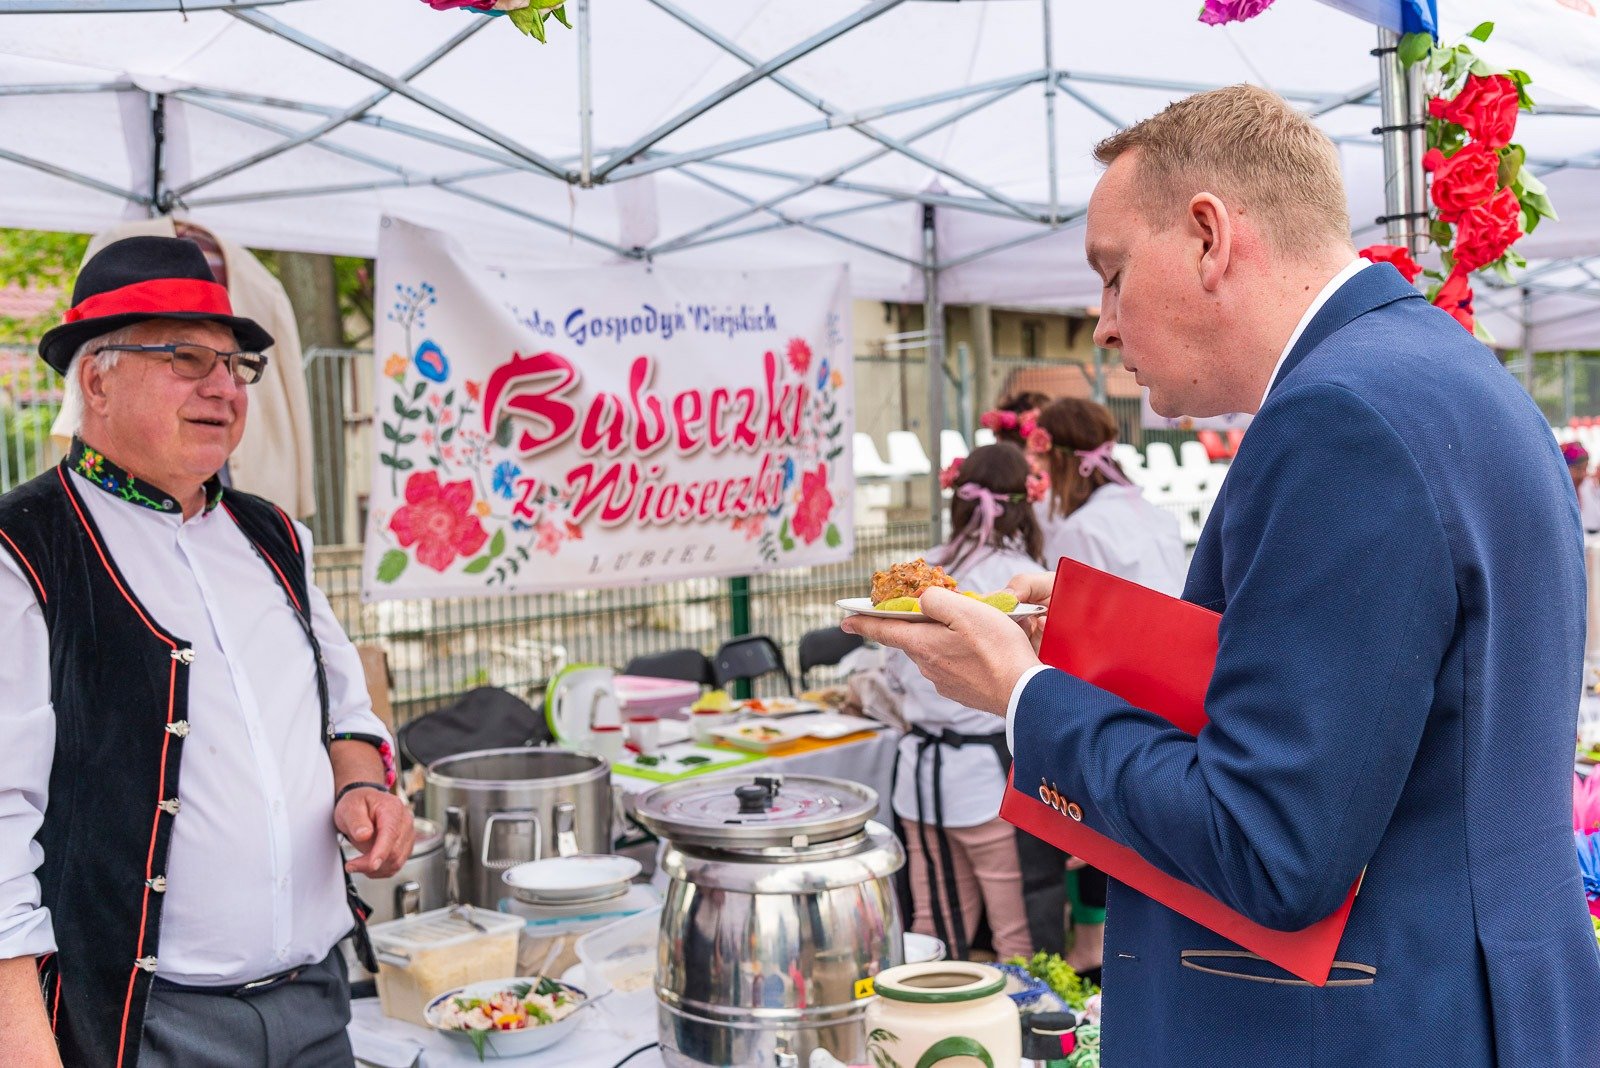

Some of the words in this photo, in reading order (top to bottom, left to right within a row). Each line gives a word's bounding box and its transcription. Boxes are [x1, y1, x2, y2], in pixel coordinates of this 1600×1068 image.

[482, 350, 807, 454] Babeczki
[512, 477, 537, 519] z
[566, 452, 784, 522] Wioseczki
